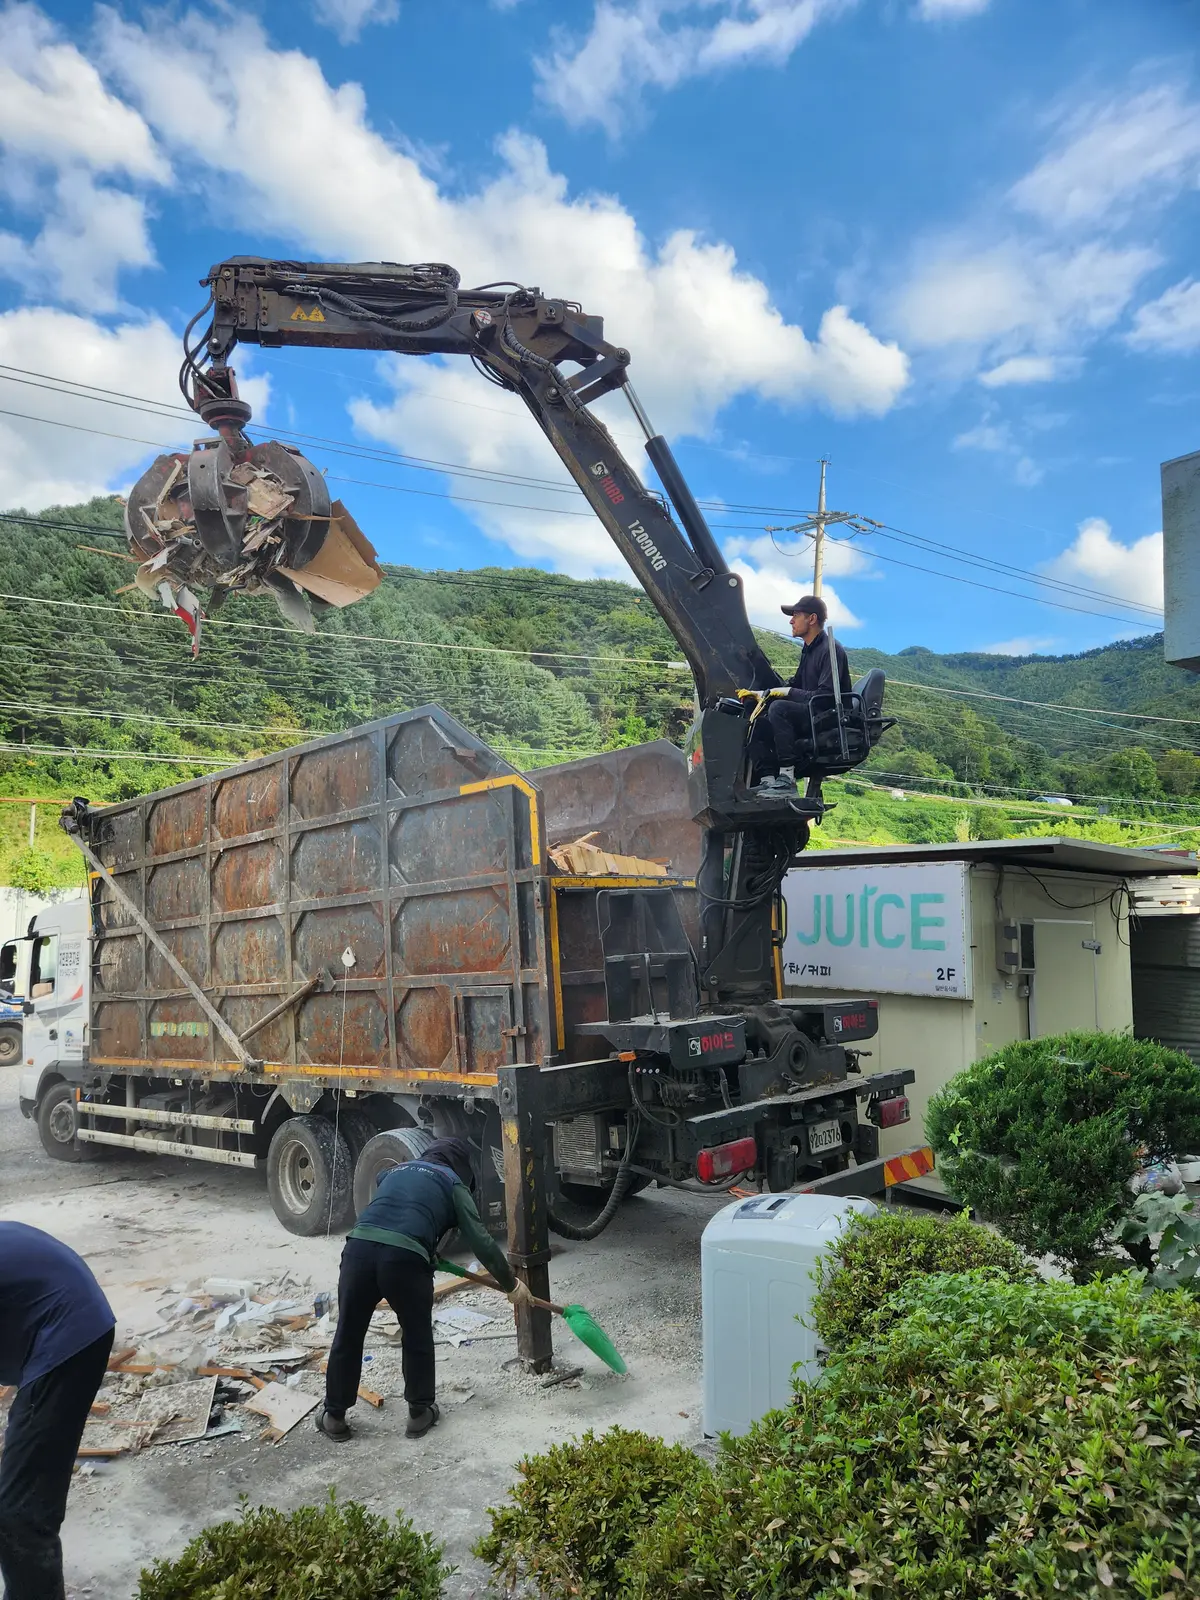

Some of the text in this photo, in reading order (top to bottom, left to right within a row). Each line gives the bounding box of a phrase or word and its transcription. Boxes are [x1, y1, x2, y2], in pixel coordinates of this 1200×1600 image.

[628, 519, 668, 572] 12000XG
[796, 885, 946, 950] JUICE
[936, 967, 956, 981] 2F
